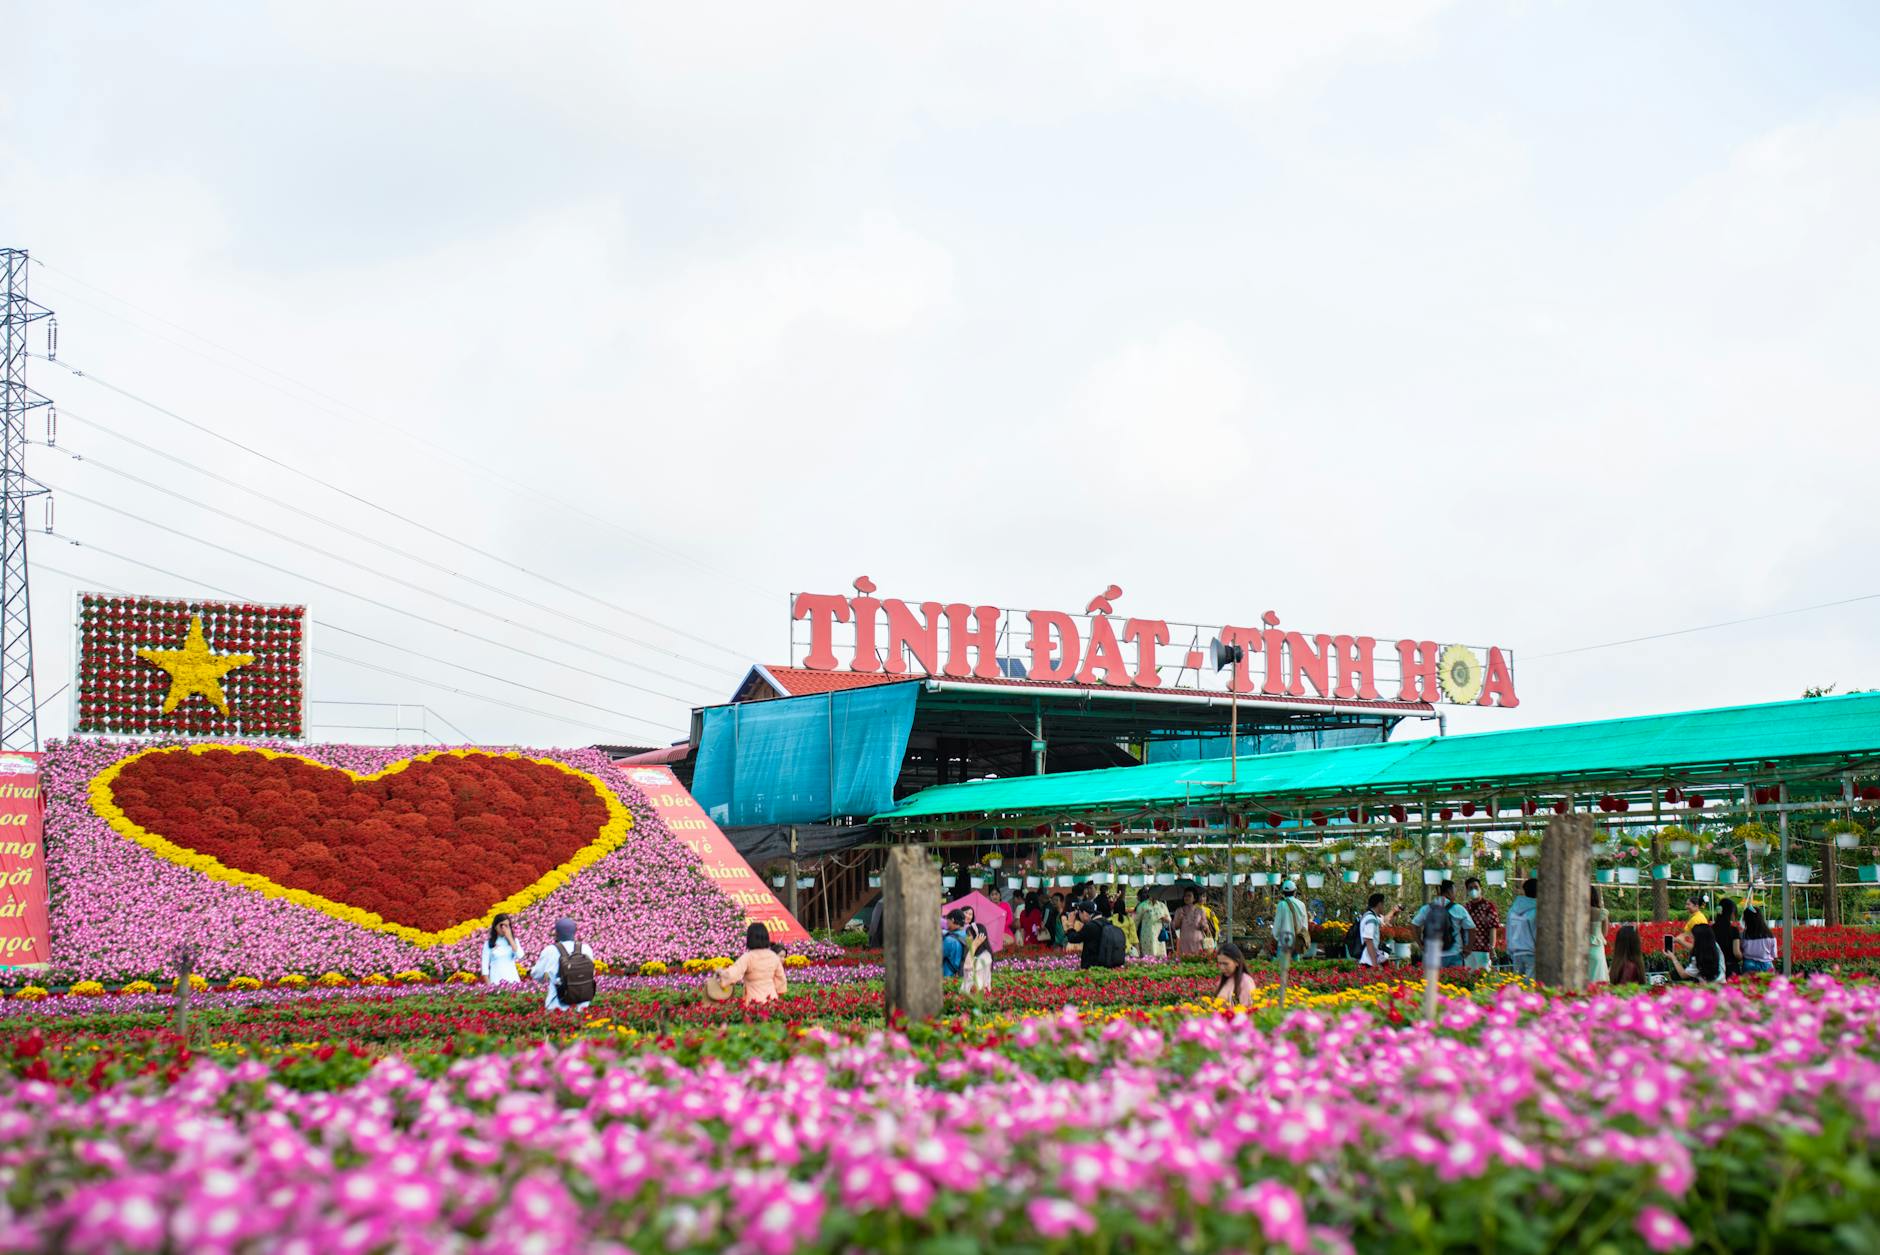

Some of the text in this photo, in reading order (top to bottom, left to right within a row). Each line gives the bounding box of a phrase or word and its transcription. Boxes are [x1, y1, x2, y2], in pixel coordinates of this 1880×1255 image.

[1025, 584, 1170, 688] ĐẤT
[660, 793, 693, 807] Đéc
[700, 859, 751, 879] hắm
